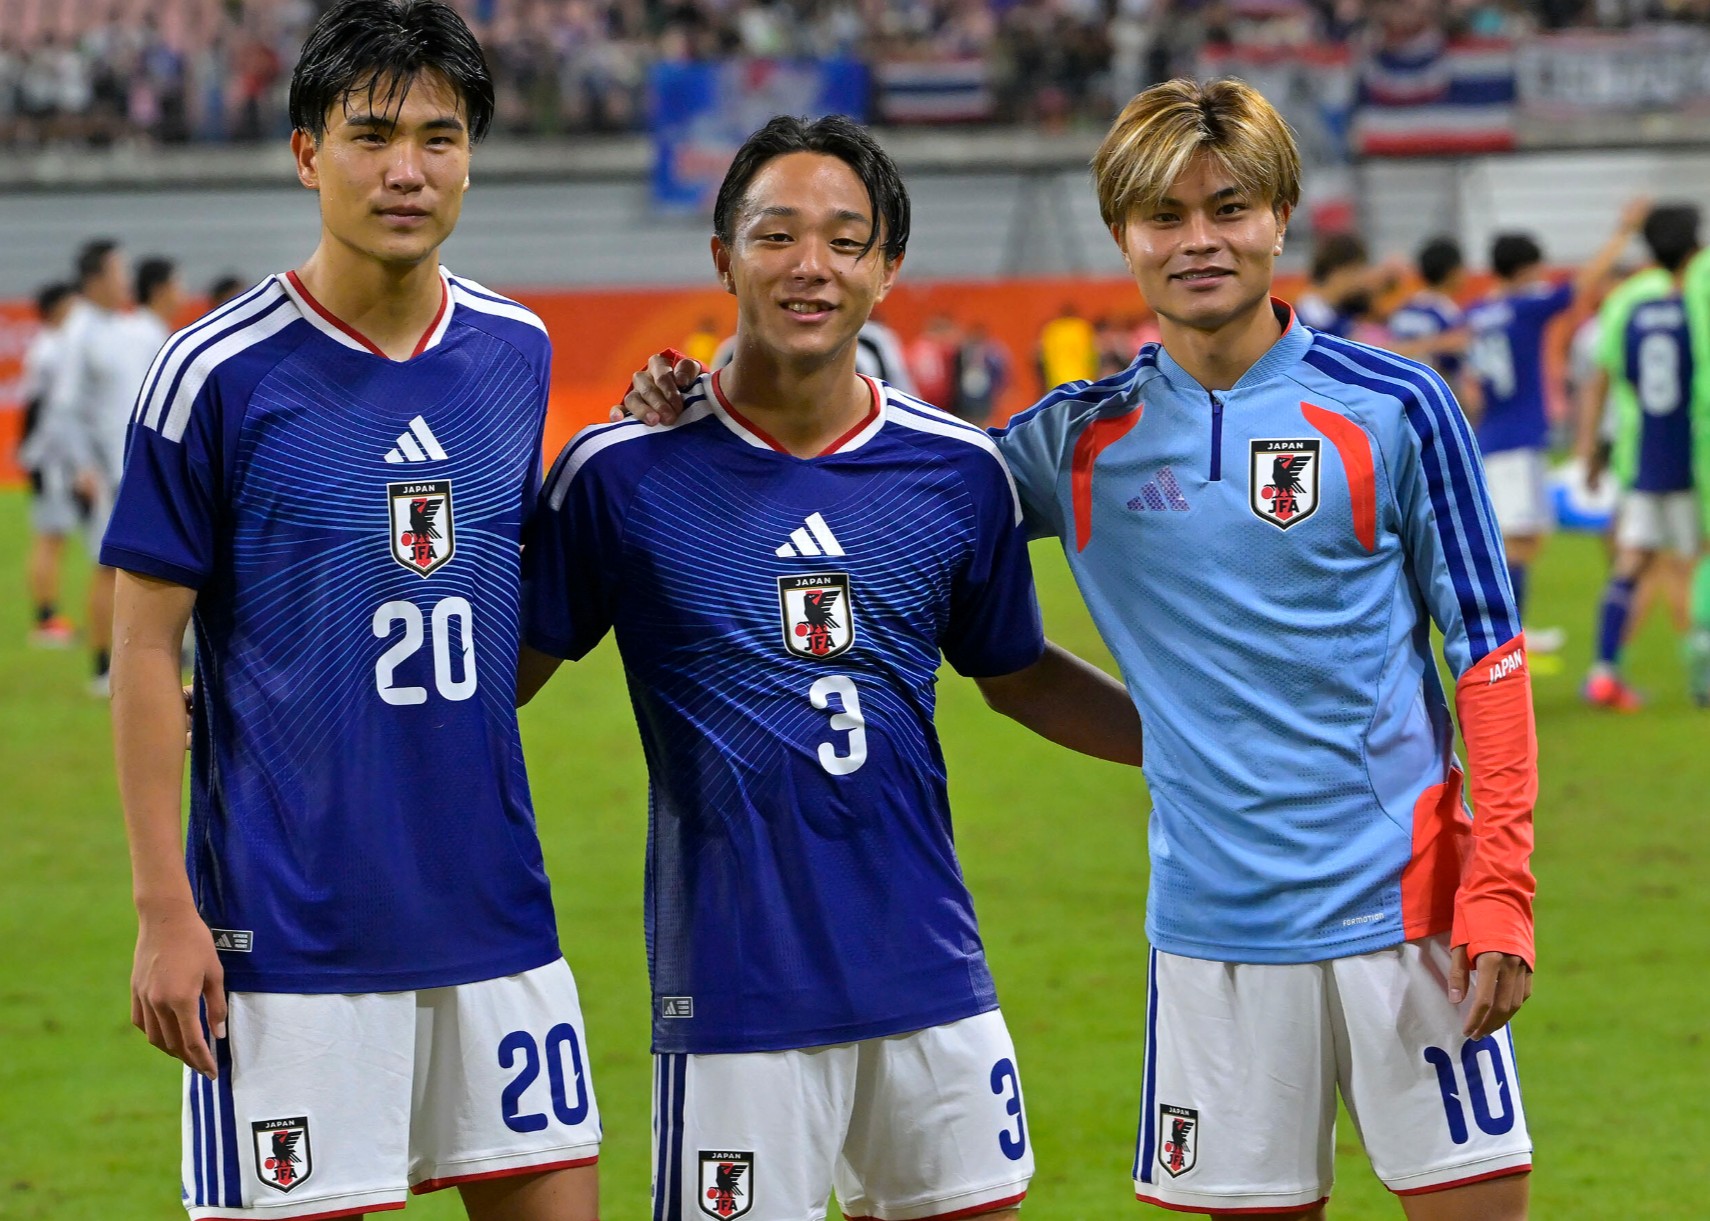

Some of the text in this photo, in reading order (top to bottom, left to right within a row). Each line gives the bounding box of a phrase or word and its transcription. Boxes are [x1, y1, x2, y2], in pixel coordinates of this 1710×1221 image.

[1267, 442, 1304, 450] JAPAN
[403, 484, 435, 494] JAPAN
[1268, 500, 1300, 513] JFA
[409, 544, 438, 561] JFA
[795, 576, 832, 586] JAPAN
[804, 634, 836, 651] JFA
[372, 596, 477, 706] 20
[1489, 648, 1522, 686] JAPAN
[809, 675, 867, 776] 3
[497, 1022, 589, 1133] 20
[1423, 1035, 1515, 1144] 10
[990, 1057, 1026, 1161] 3
[1168, 1106, 1190, 1116] JAPAN
[265, 1119, 295, 1129] JAPAN
[1166, 1153, 1185, 1168] JFA
[272, 1167, 298, 1181] JFA
[712, 1199, 738, 1211] JFA
